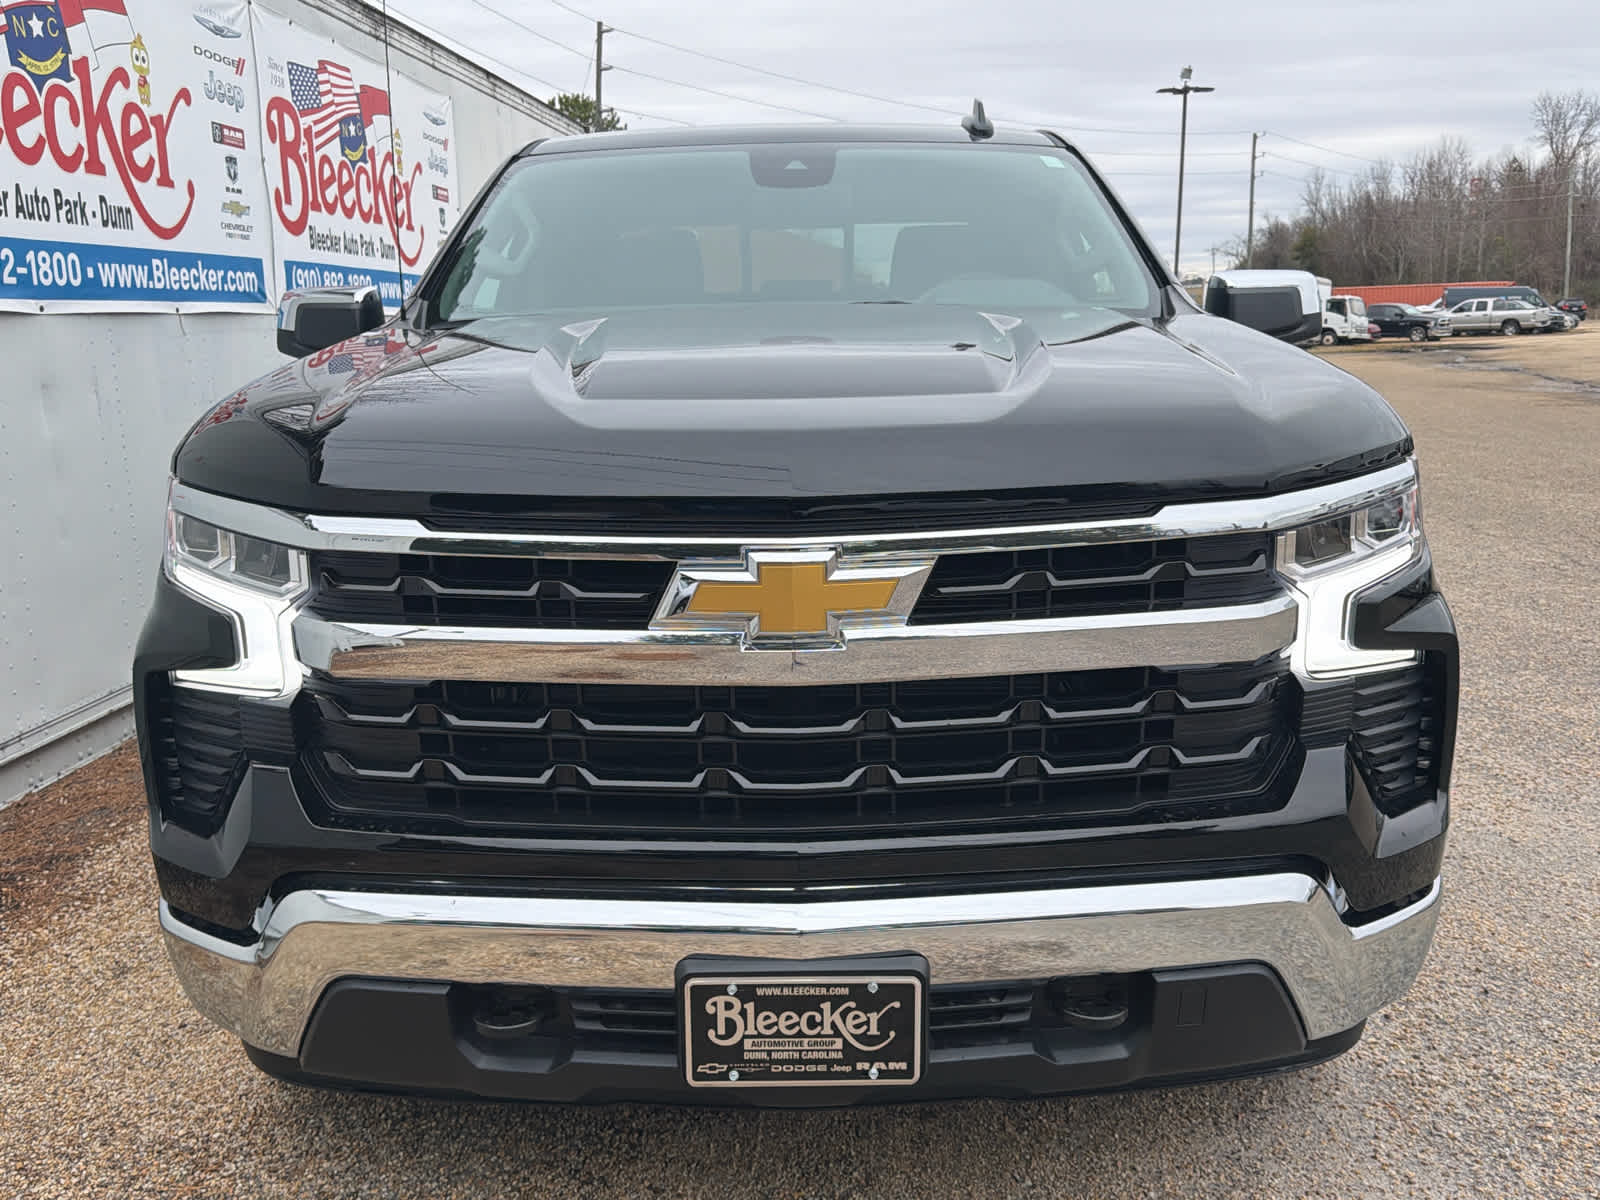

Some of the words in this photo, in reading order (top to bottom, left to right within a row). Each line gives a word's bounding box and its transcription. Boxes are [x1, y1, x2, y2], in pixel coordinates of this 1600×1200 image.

[12, 15, 26, 38] N
[47, 17, 59, 37] C
[194, 45, 239, 69] DODGE
[204, 70, 245, 112] Jeep
[222, 127, 243, 140] RAM
[0, 58, 195, 241] ecker
[225, 186, 243, 194] RAM
[15, 182, 51, 222] Auto
[53, 188, 89, 227] Park
[99, 195, 134, 231] Dunn
[220, 222, 254, 233] CHEVROLET
[308, 225, 341, 254] Bleecker
[343, 230, 359, 256] Auto
[359, 233, 376, 258] Park
[379, 237, 396, 260] Dunn
[0, 248, 82, 287] 2-1800
[97, 257, 259, 293] www.Bleecker.com
[756, 987, 849, 996] WWW.BLEECKER.COM
[705, 995, 901, 1051] Bleecker
[751, 1039, 804, 1048] AUTOMOTIVE
[807, 1039, 836, 1048] GROUP
[743, 1051, 769, 1061] DUNN,
[771, 1051, 800, 1060] NORTH
[801, 1051, 844, 1060] CAROLINA
[770, 1064, 828, 1072] DODGE
[830, 1063, 852, 1073] Jeep
[856, 1061, 908, 1071] RAM
